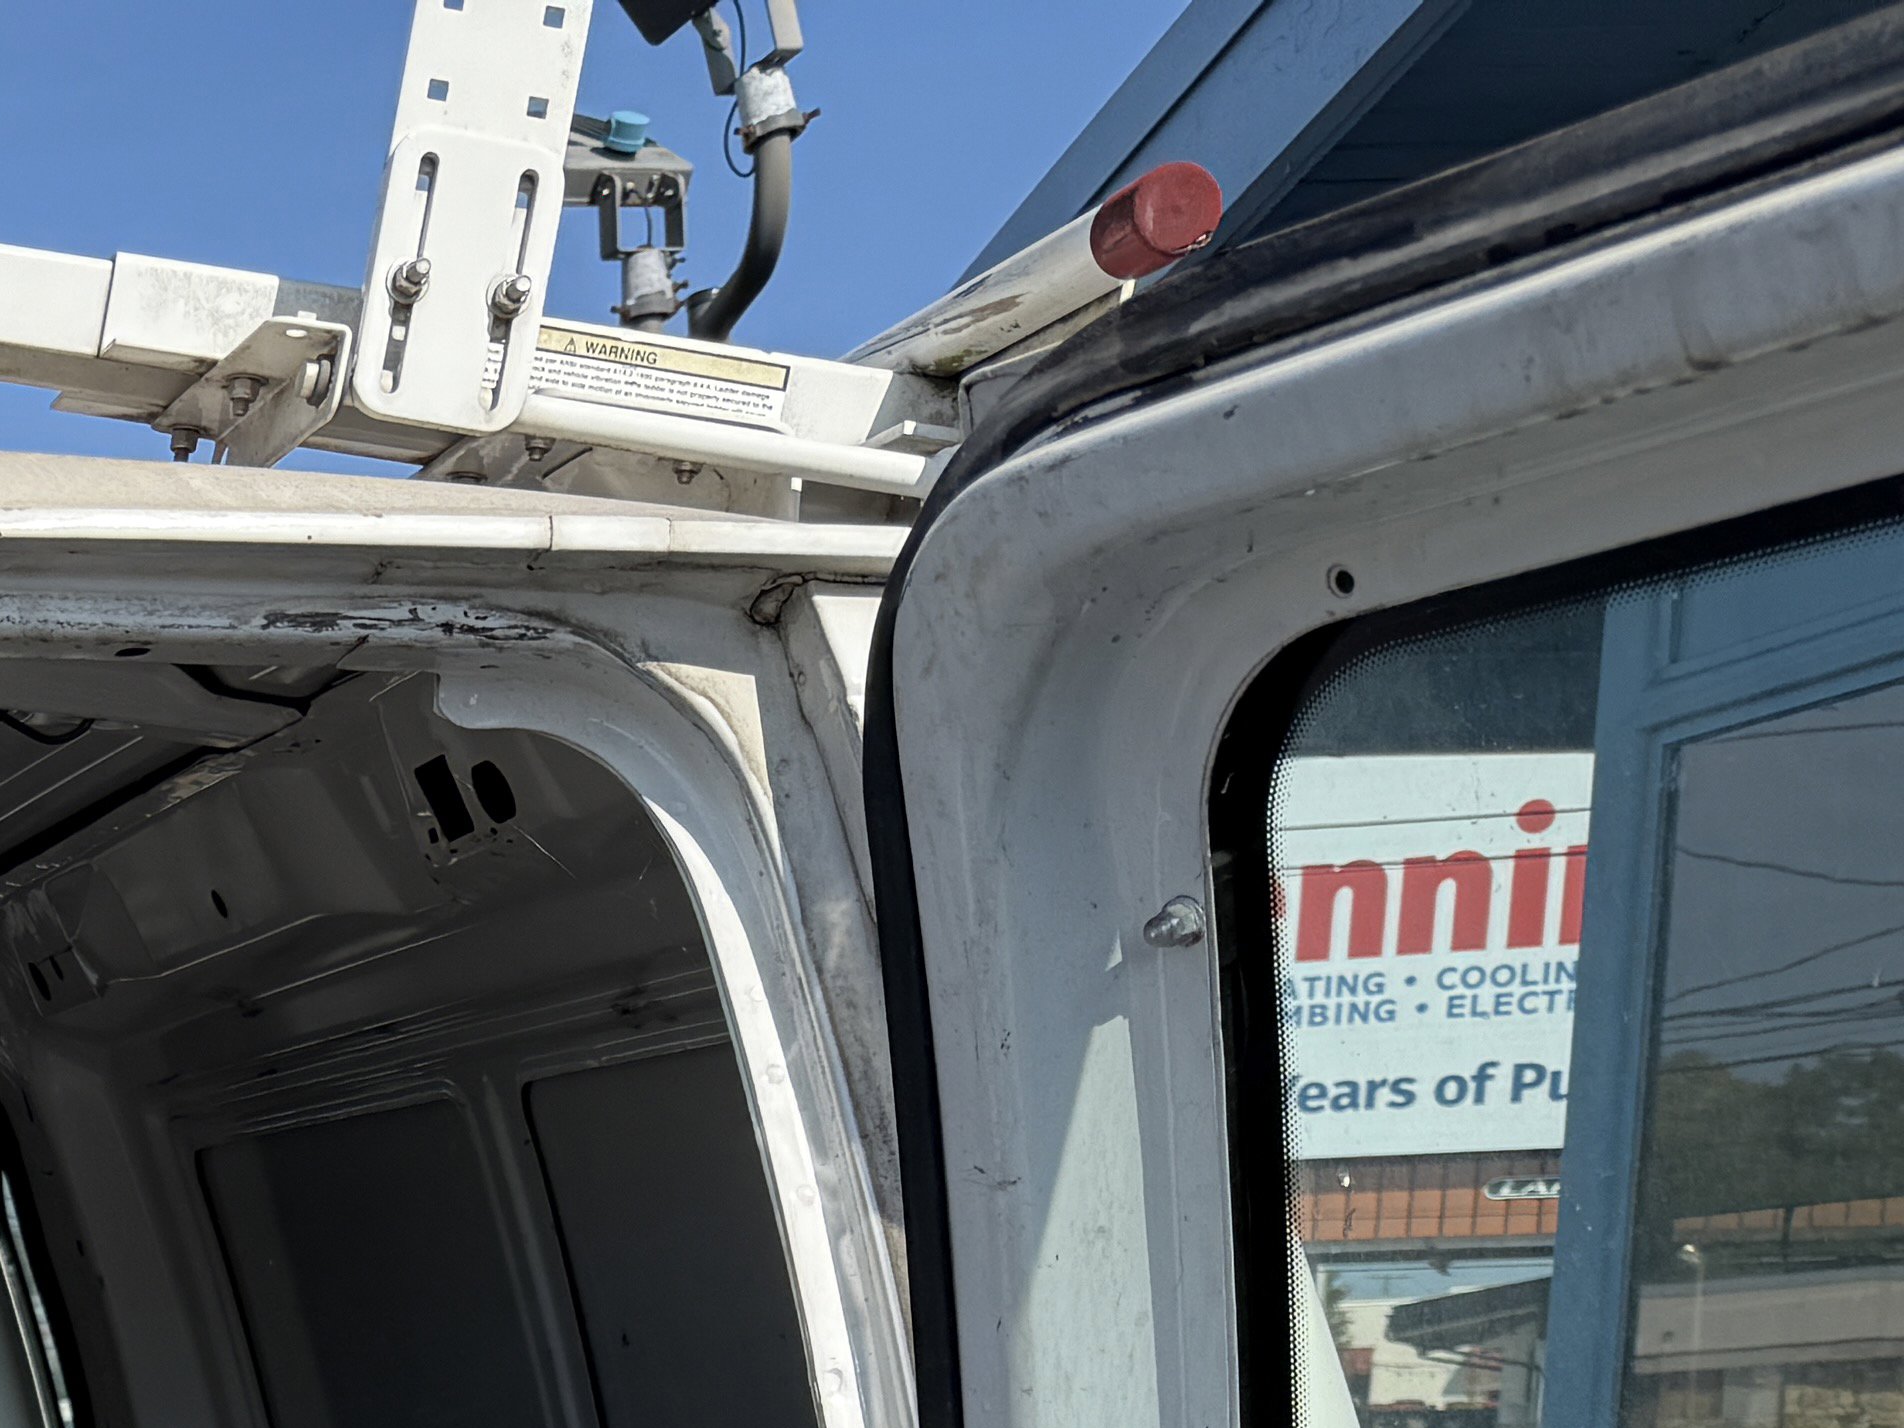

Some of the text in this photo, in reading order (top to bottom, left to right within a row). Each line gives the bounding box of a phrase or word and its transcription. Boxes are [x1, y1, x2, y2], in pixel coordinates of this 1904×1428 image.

[585, 340, 658, 365] WARNING
[1292, 1074, 1417, 1114] ears
[1434, 1061, 1500, 1108] of
